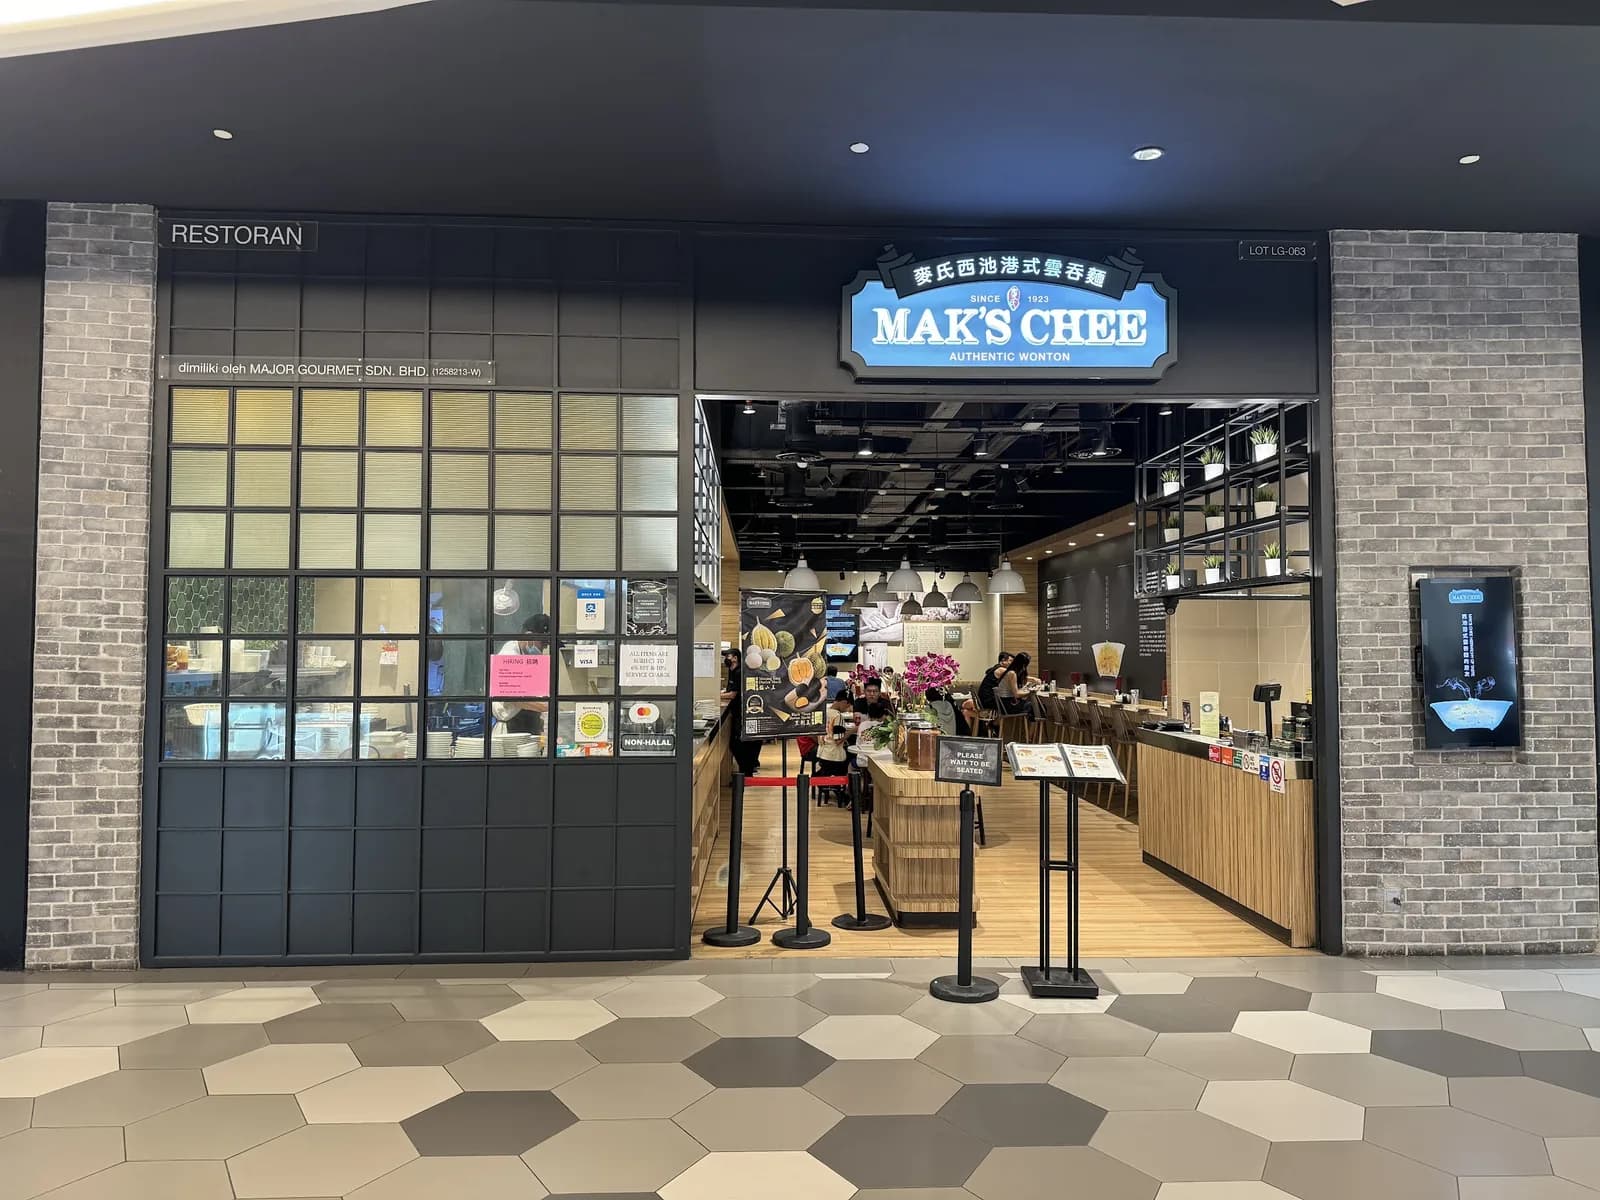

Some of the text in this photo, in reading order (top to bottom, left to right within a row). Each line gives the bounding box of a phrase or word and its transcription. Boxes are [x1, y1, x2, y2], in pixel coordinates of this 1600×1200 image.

[171, 224, 303, 247] RESTORAN
[1249, 245, 1307, 257] LOT LG-063
[970, 294, 1050, 304] SINCE 1923
[871, 306, 1148, 347] MAK'S CHEE
[949, 352, 1071, 362] AUTHENTIC WONTON
[178, 362, 482, 378] dimiliki oleh MAJOR GOURMET SDN. BHD. (1258213-W)
[624, 738, 672, 746] NON-HALAL
[956, 752, 984, 760] PLEASE
[956, 767, 984, 775] SEATED
